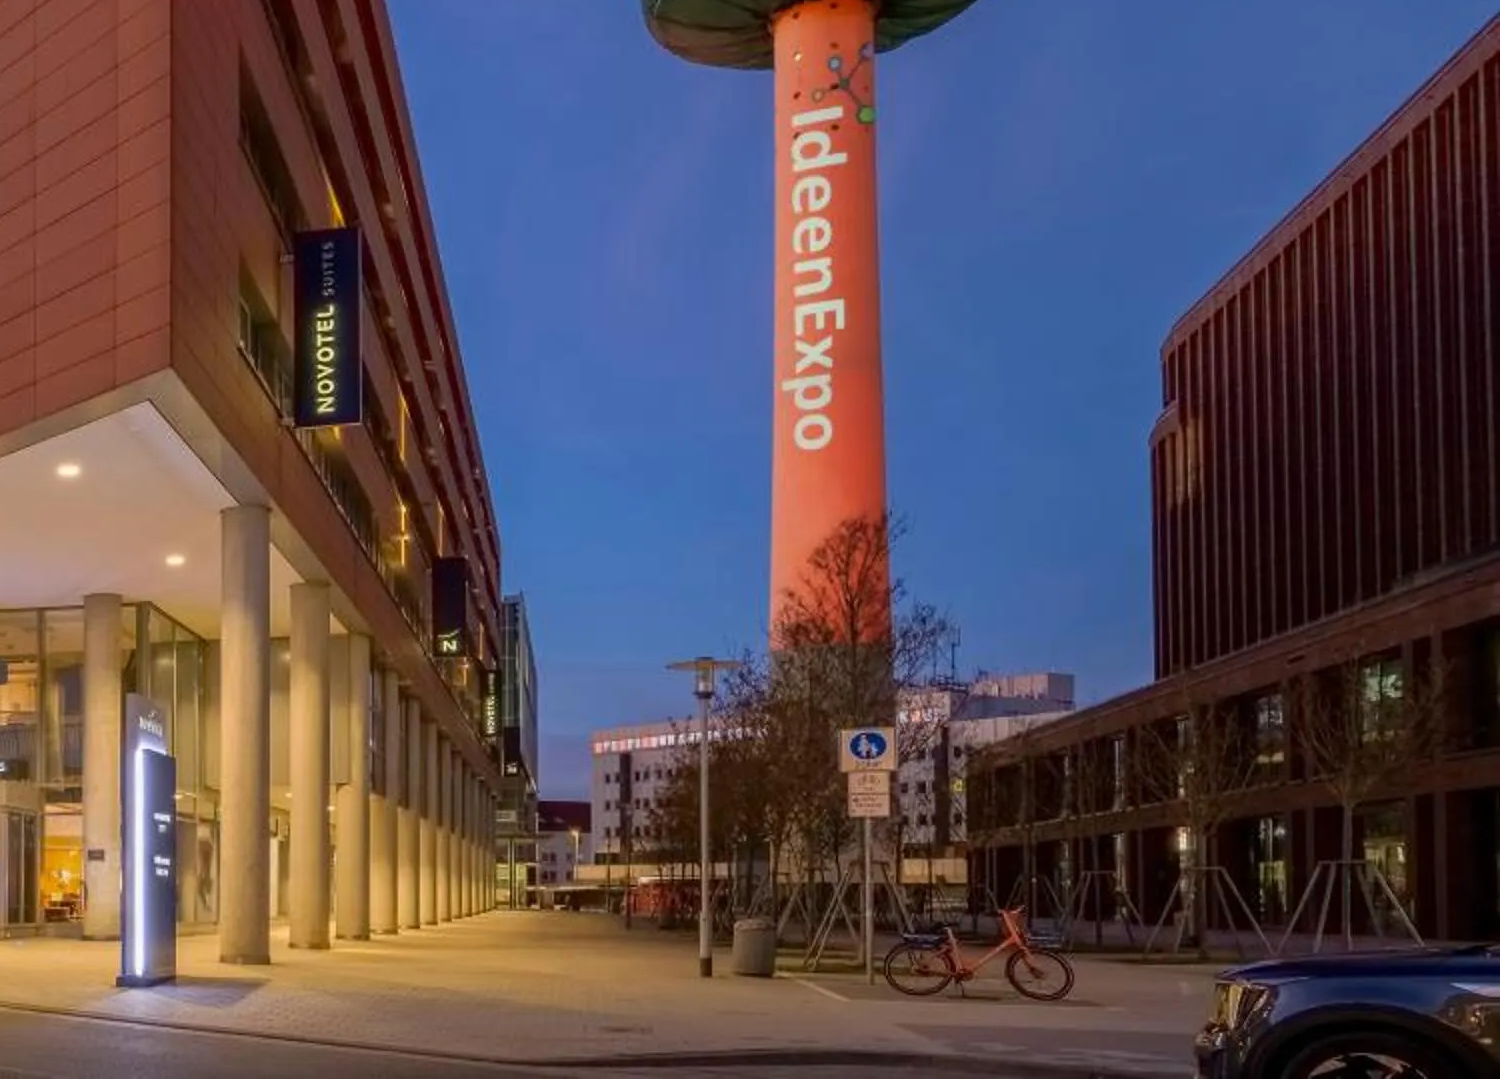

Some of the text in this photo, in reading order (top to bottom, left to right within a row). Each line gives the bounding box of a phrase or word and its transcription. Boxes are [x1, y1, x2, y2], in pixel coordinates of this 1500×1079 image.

[316, 241, 336, 415] NOVOTEL SUITES
[781, 105, 849, 452] IdeenExpo
